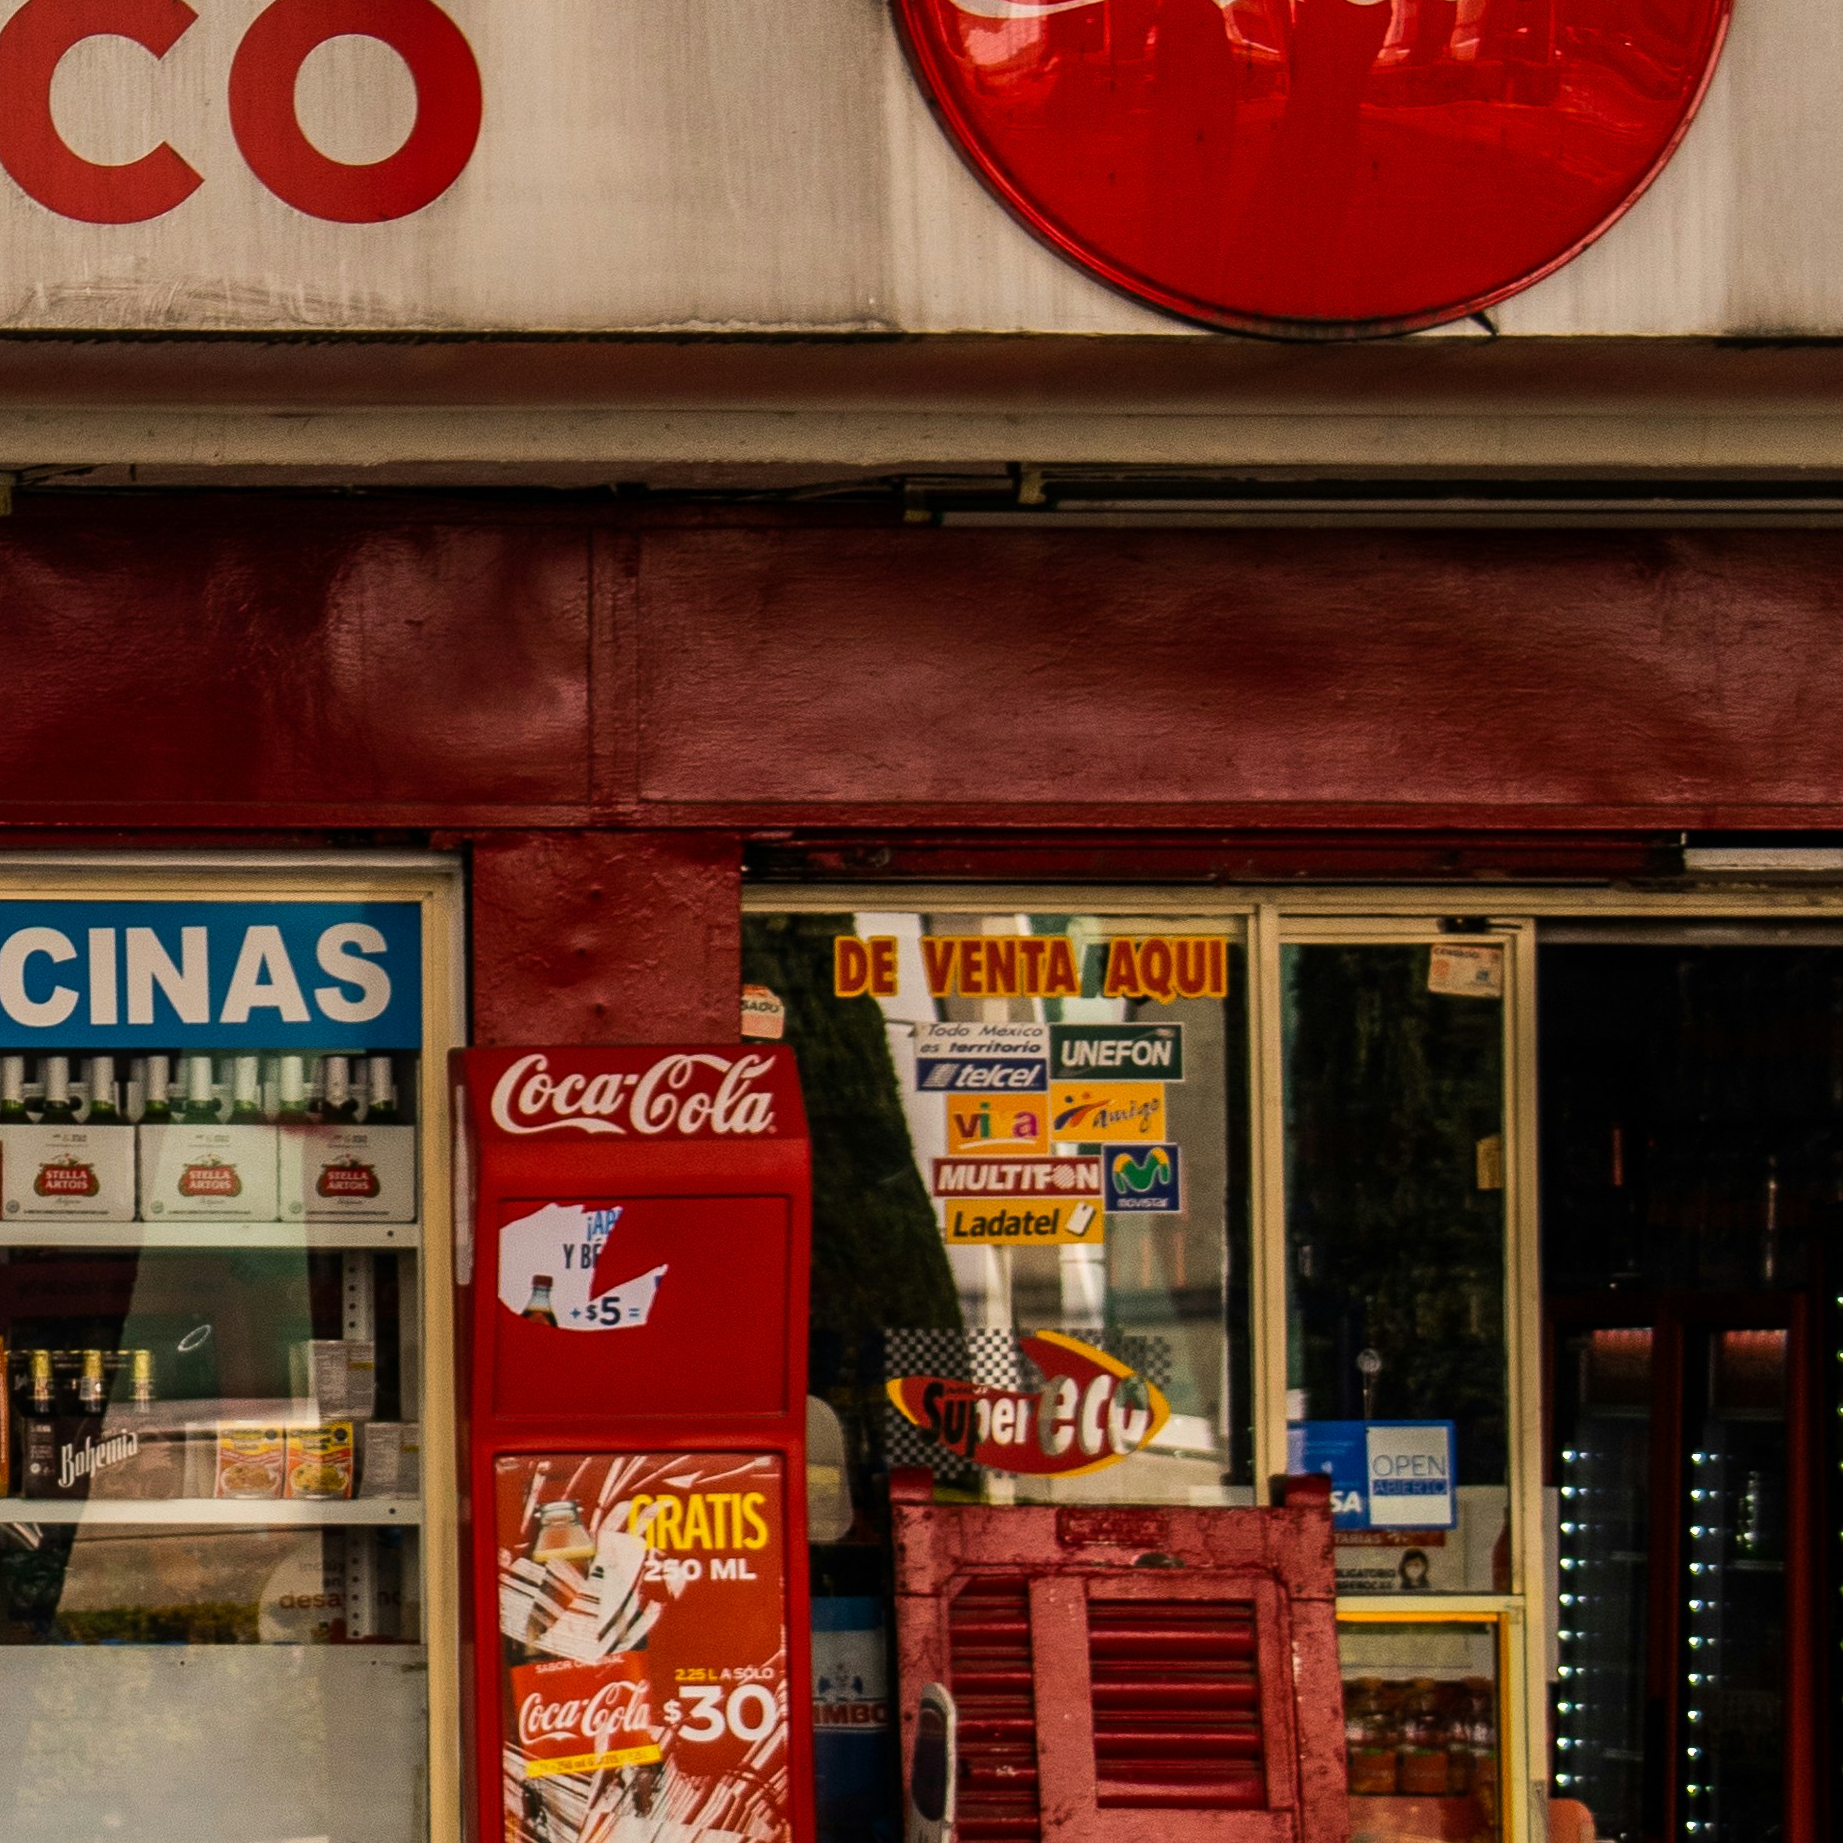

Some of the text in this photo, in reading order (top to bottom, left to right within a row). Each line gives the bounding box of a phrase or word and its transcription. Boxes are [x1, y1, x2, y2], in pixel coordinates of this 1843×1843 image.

[834, 935, 1228, 1005] DE VENTA AQUI
[928, 1023, 970, 1037] Todo
[949, 1040, 1042, 1054] territorio
[1061, 1039, 1173, 1067] UNEFON
[956, 1062, 1038, 1088] telcel
[491, 1053, 777, 1136] Coca-Cola
[953, 1101, 1039, 1139] via
[938, 1163, 1100, 1191] MULTIFON
[953, 1209, 1059, 1238] Ladatel
[58, 1428, 139, 1488] Bohemia
[1372, 1454, 1446, 1477] OPEN
[627, 1491, 770, 1550] GRATIS
[710, 1559, 756, 1580] ML
[518, 1679, 653, 1745] Coca-Cola
[812, 1704, 891, 1724] IMBO
